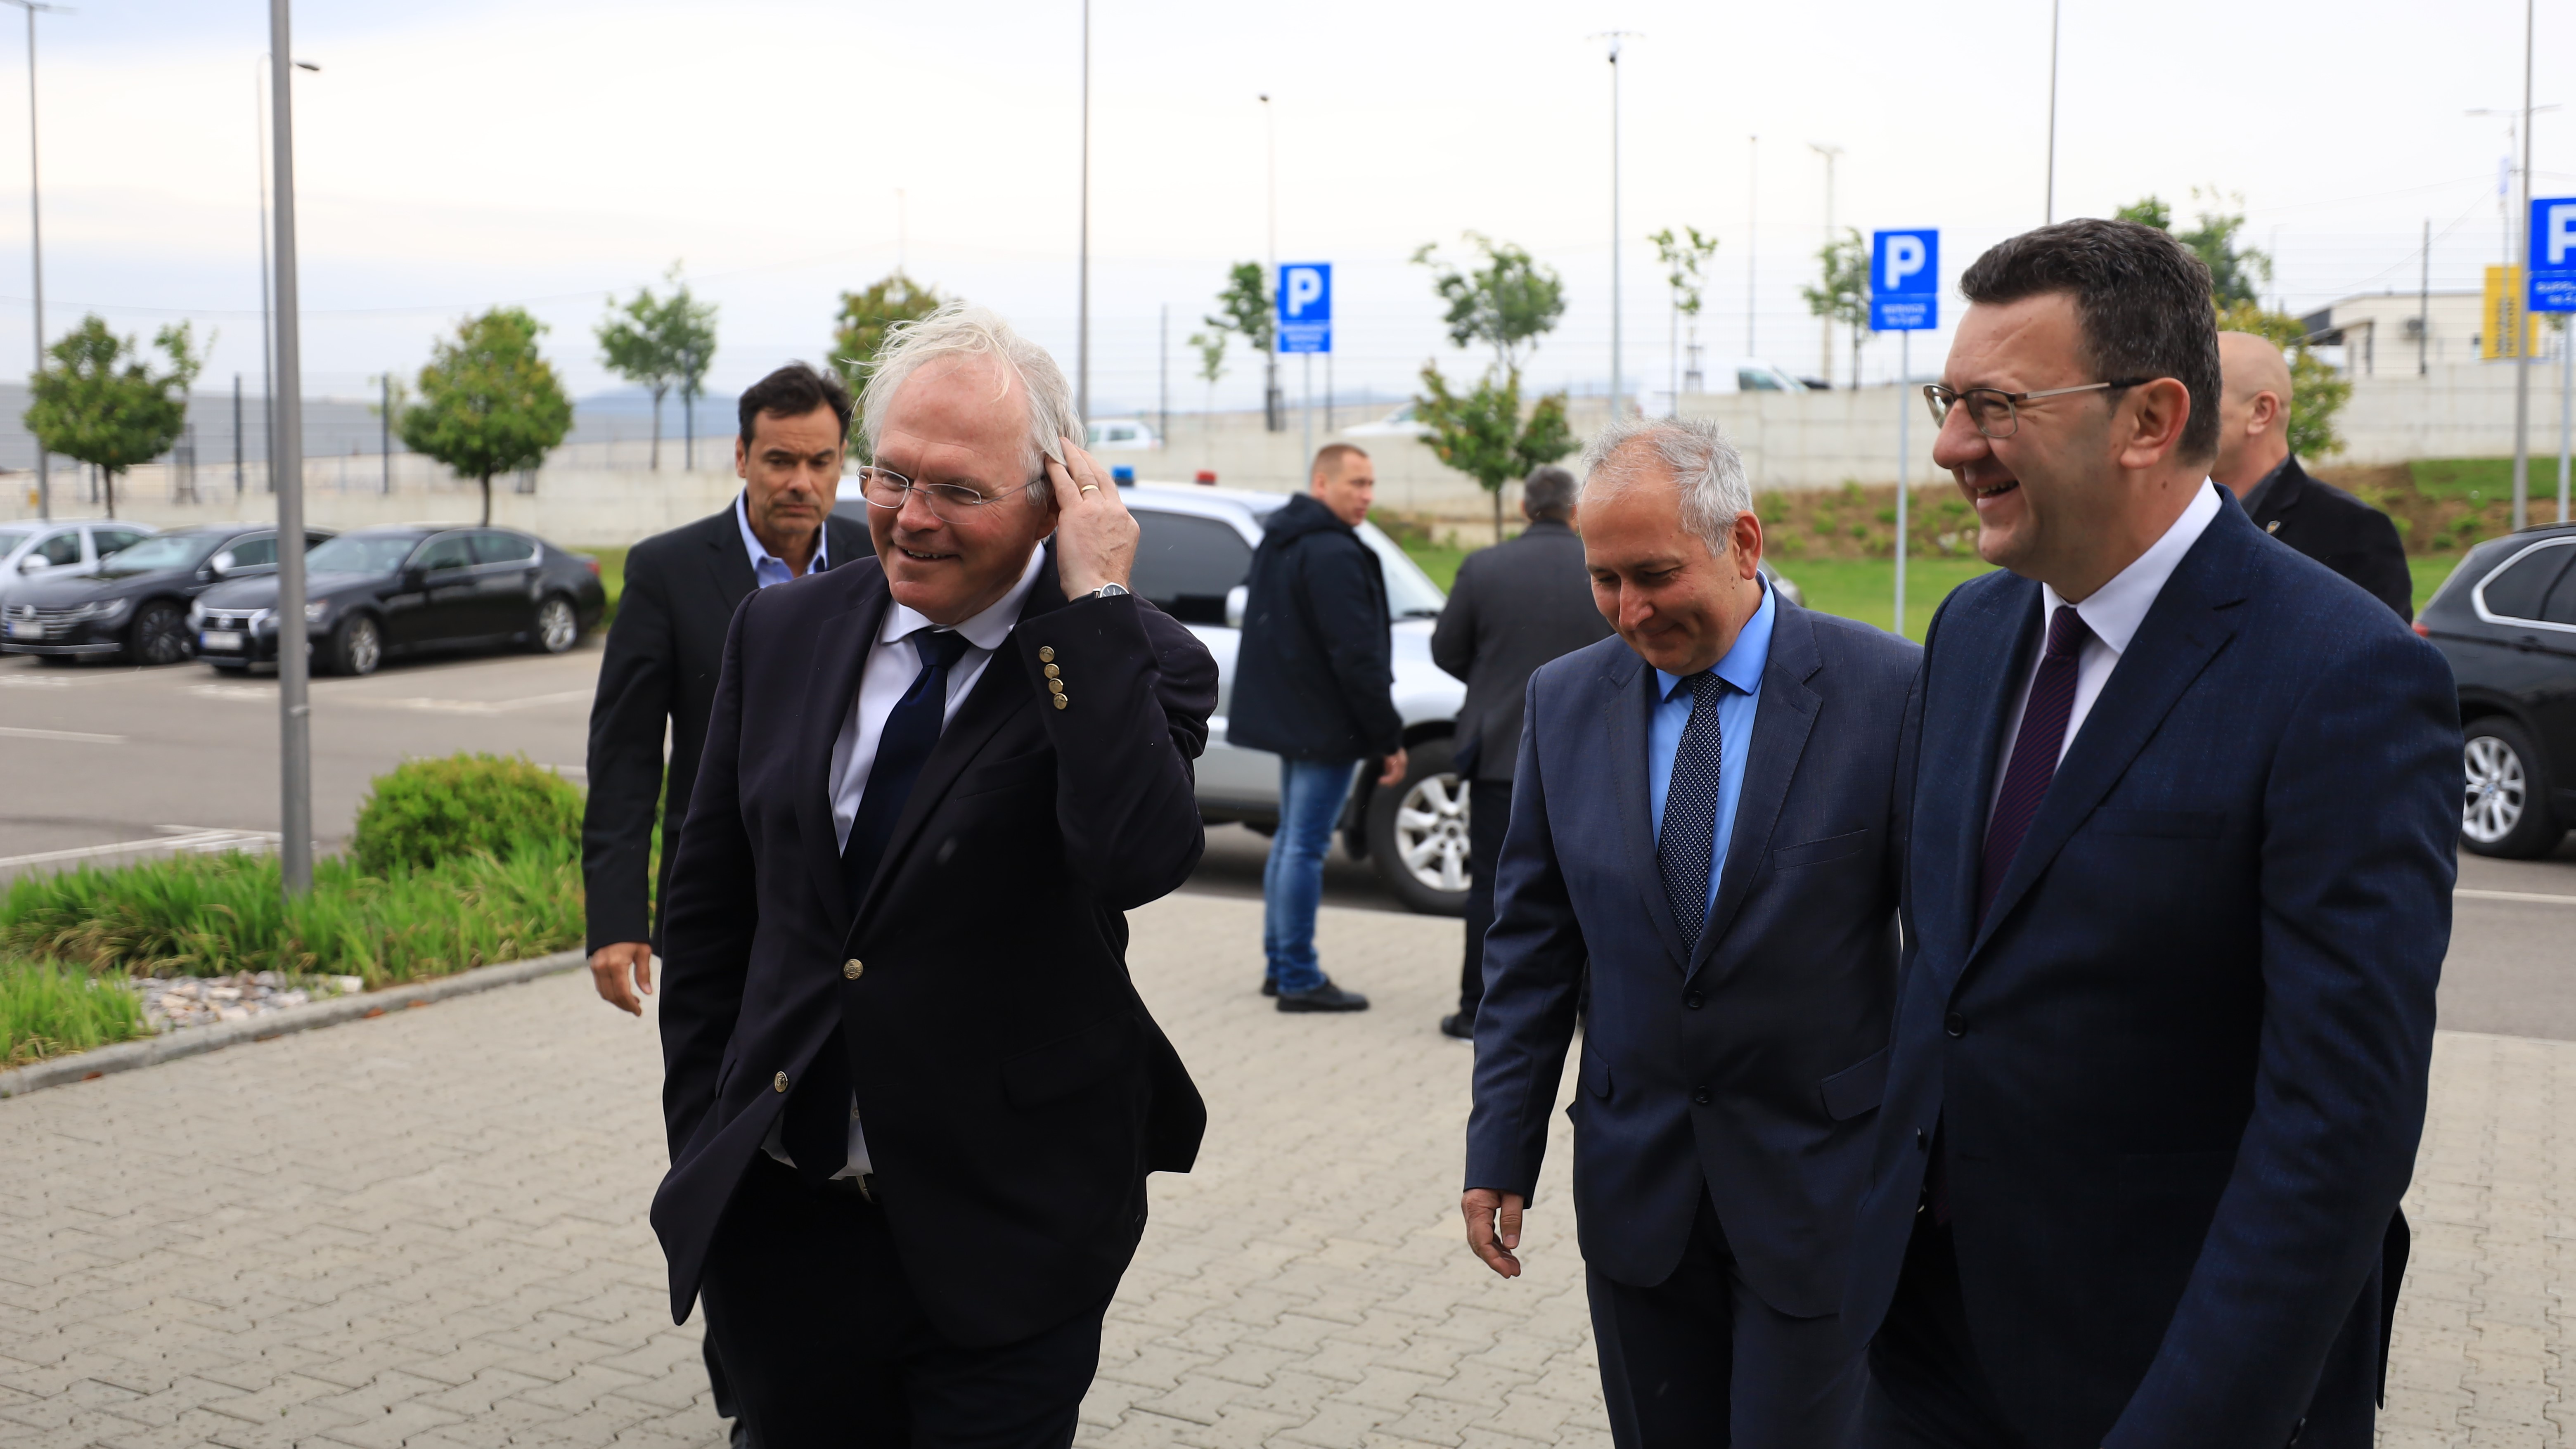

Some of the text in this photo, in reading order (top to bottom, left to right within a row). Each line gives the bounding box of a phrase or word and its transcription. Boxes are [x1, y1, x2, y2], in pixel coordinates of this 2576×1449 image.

[2547, 204, 2576, 264] P
[1885, 235, 1926, 290] P
[1287, 268, 1323, 316] P
